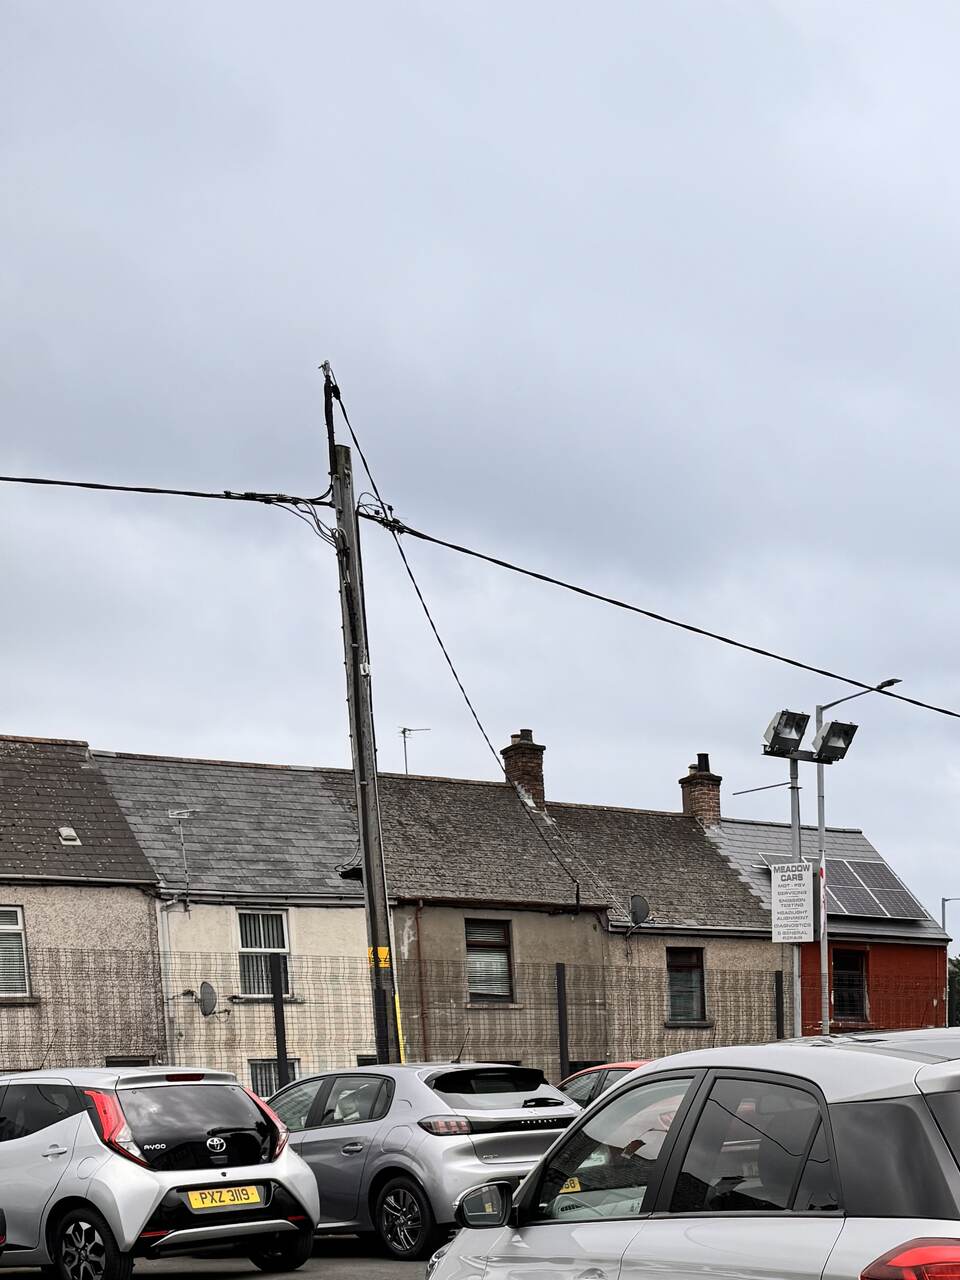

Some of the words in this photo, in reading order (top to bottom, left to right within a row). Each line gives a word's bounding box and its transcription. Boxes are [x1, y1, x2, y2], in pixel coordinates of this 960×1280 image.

[774, 865, 810, 874] MEADOW
[781, 873, 803, 881] CARS
[199, 1190, 225, 1204] PXZ
[227, 1188, 250, 1202] 3119
